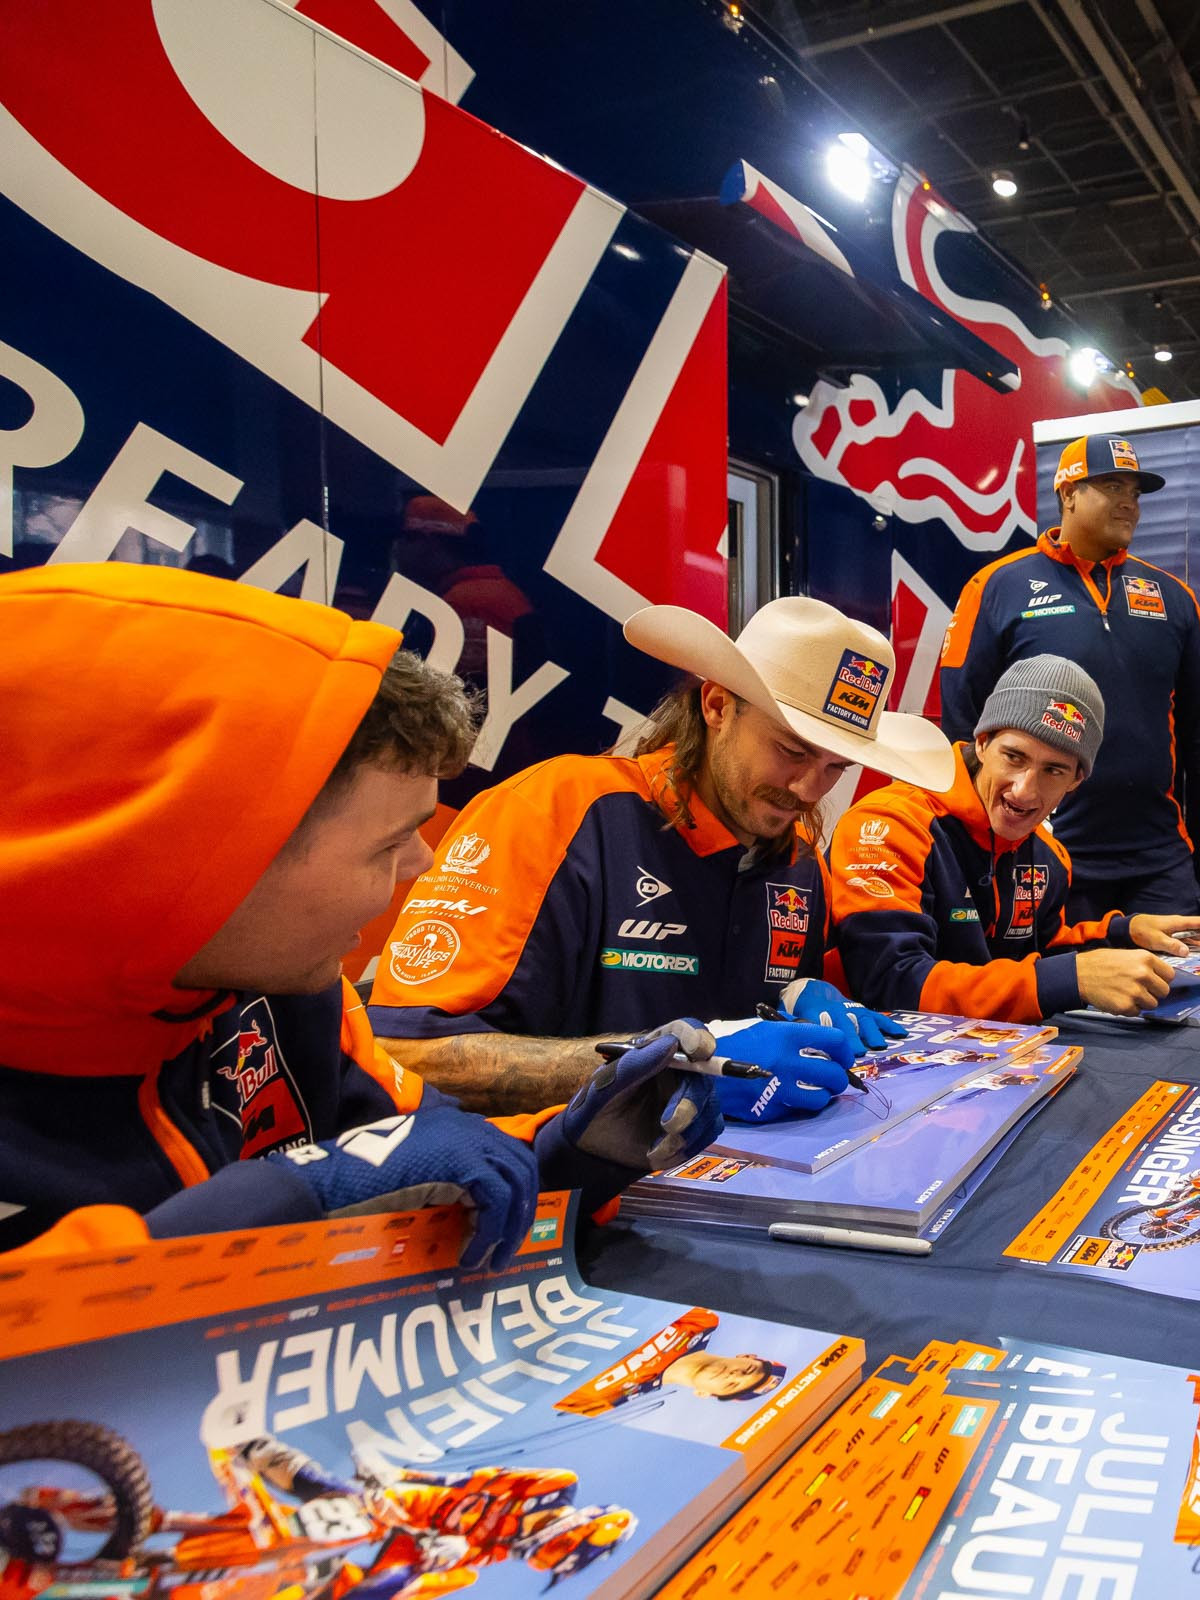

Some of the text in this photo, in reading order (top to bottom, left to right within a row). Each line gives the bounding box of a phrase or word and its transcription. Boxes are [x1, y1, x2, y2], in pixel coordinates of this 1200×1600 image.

[1028, 594, 1062, 607] WP
[1034, 605, 1073, 616] MOTOREX
[839, 667, 882, 696] Red Bull
[838, 692, 870, 710] KTM
[826, 703, 868, 726] FACTORY RACING
[1041, 712, 1082, 743] Red Bull
[449, 876, 500, 896] UNIVERSITY
[617, 919, 688, 941] WP
[770, 909, 791, 929] Red
[406, 926, 425, 941] PROUD
[437, 926, 456, 949] SUPPORT
[622, 952, 697, 972] MOTOREX
[768, 967, 790, 979] FACTORY
[239, 1043, 279, 1104] Bull
[750, 1076, 782, 1118] THOR
[915, 1180, 943, 1204] KTM.COM
[929, 1208, 955, 1234] KTM.COM
[1080, 1241, 1100, 1262] KTM
[201, 1274, 603, 1448] BEAUMER
[819, 1342, 849, 1369] KTM
[347, 1305, 640, 1473] JULIEN
[734, 1408, 779, 1446] RACING
[936, 1404, 1097, 1600] BEAU
[1041, 1412, 1170, 1600] JULIE
